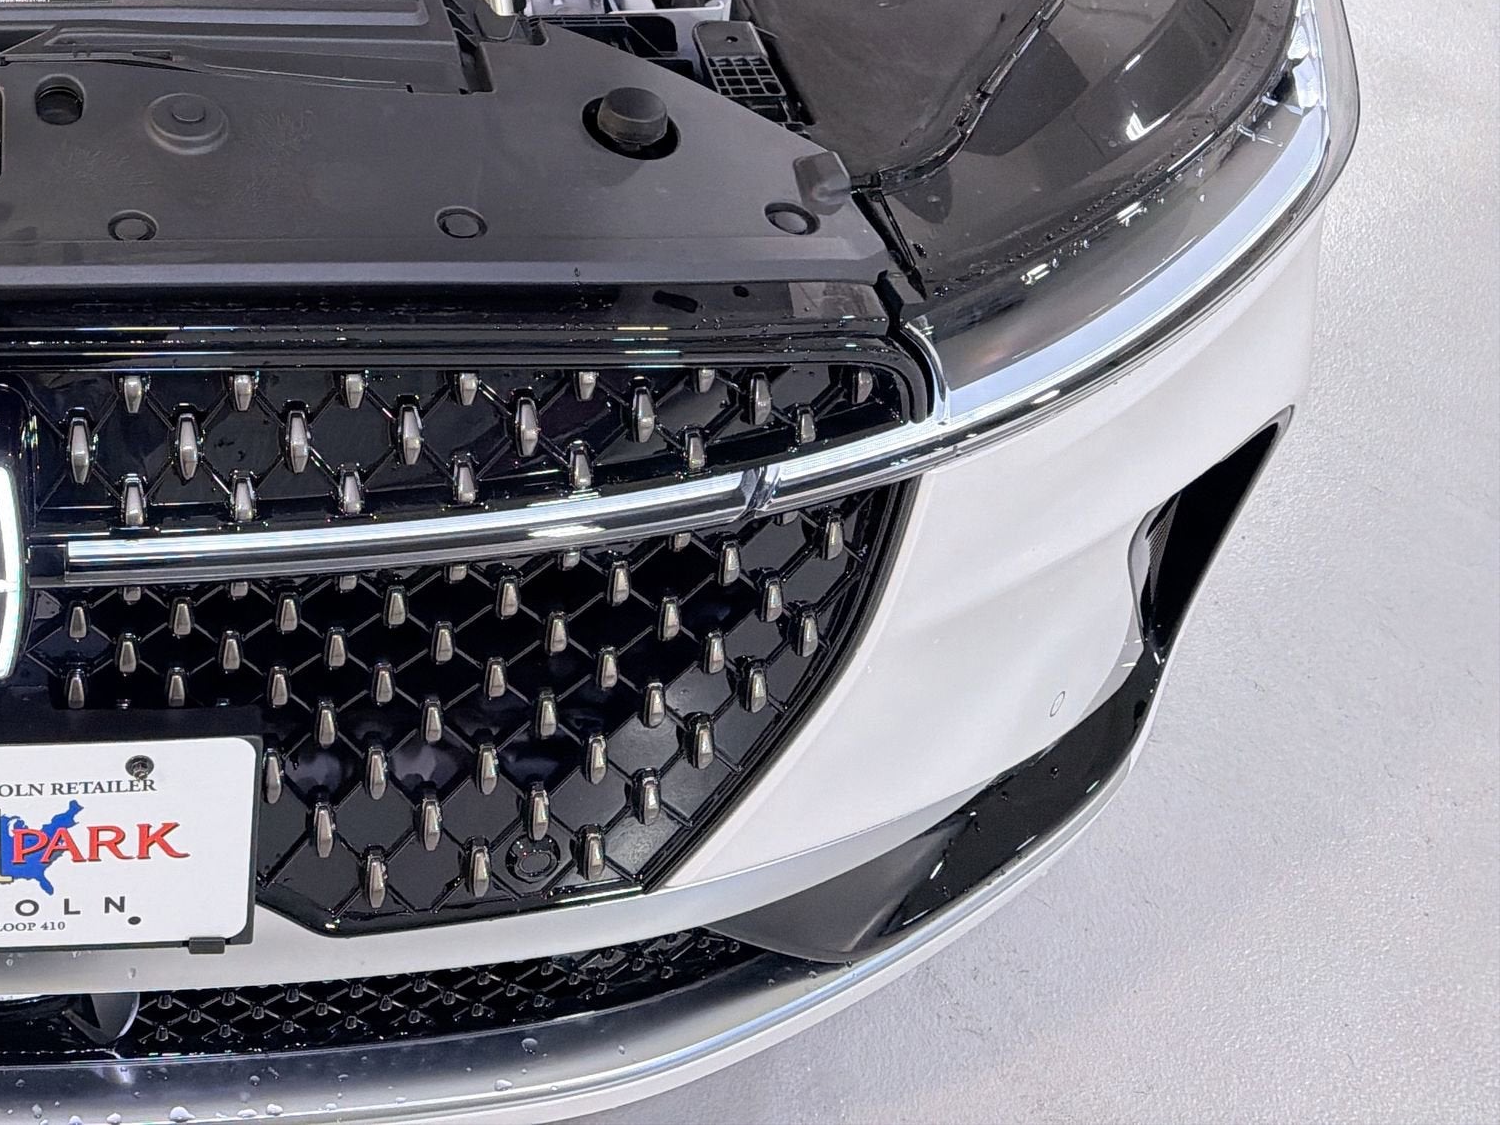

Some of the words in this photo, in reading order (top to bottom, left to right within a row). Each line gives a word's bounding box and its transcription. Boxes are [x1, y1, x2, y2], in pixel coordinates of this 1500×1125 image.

[50, 778, 157, 796] RETAILER
[11, 822, 191, 865] PARK
[40, 921, 66, 932] 410
